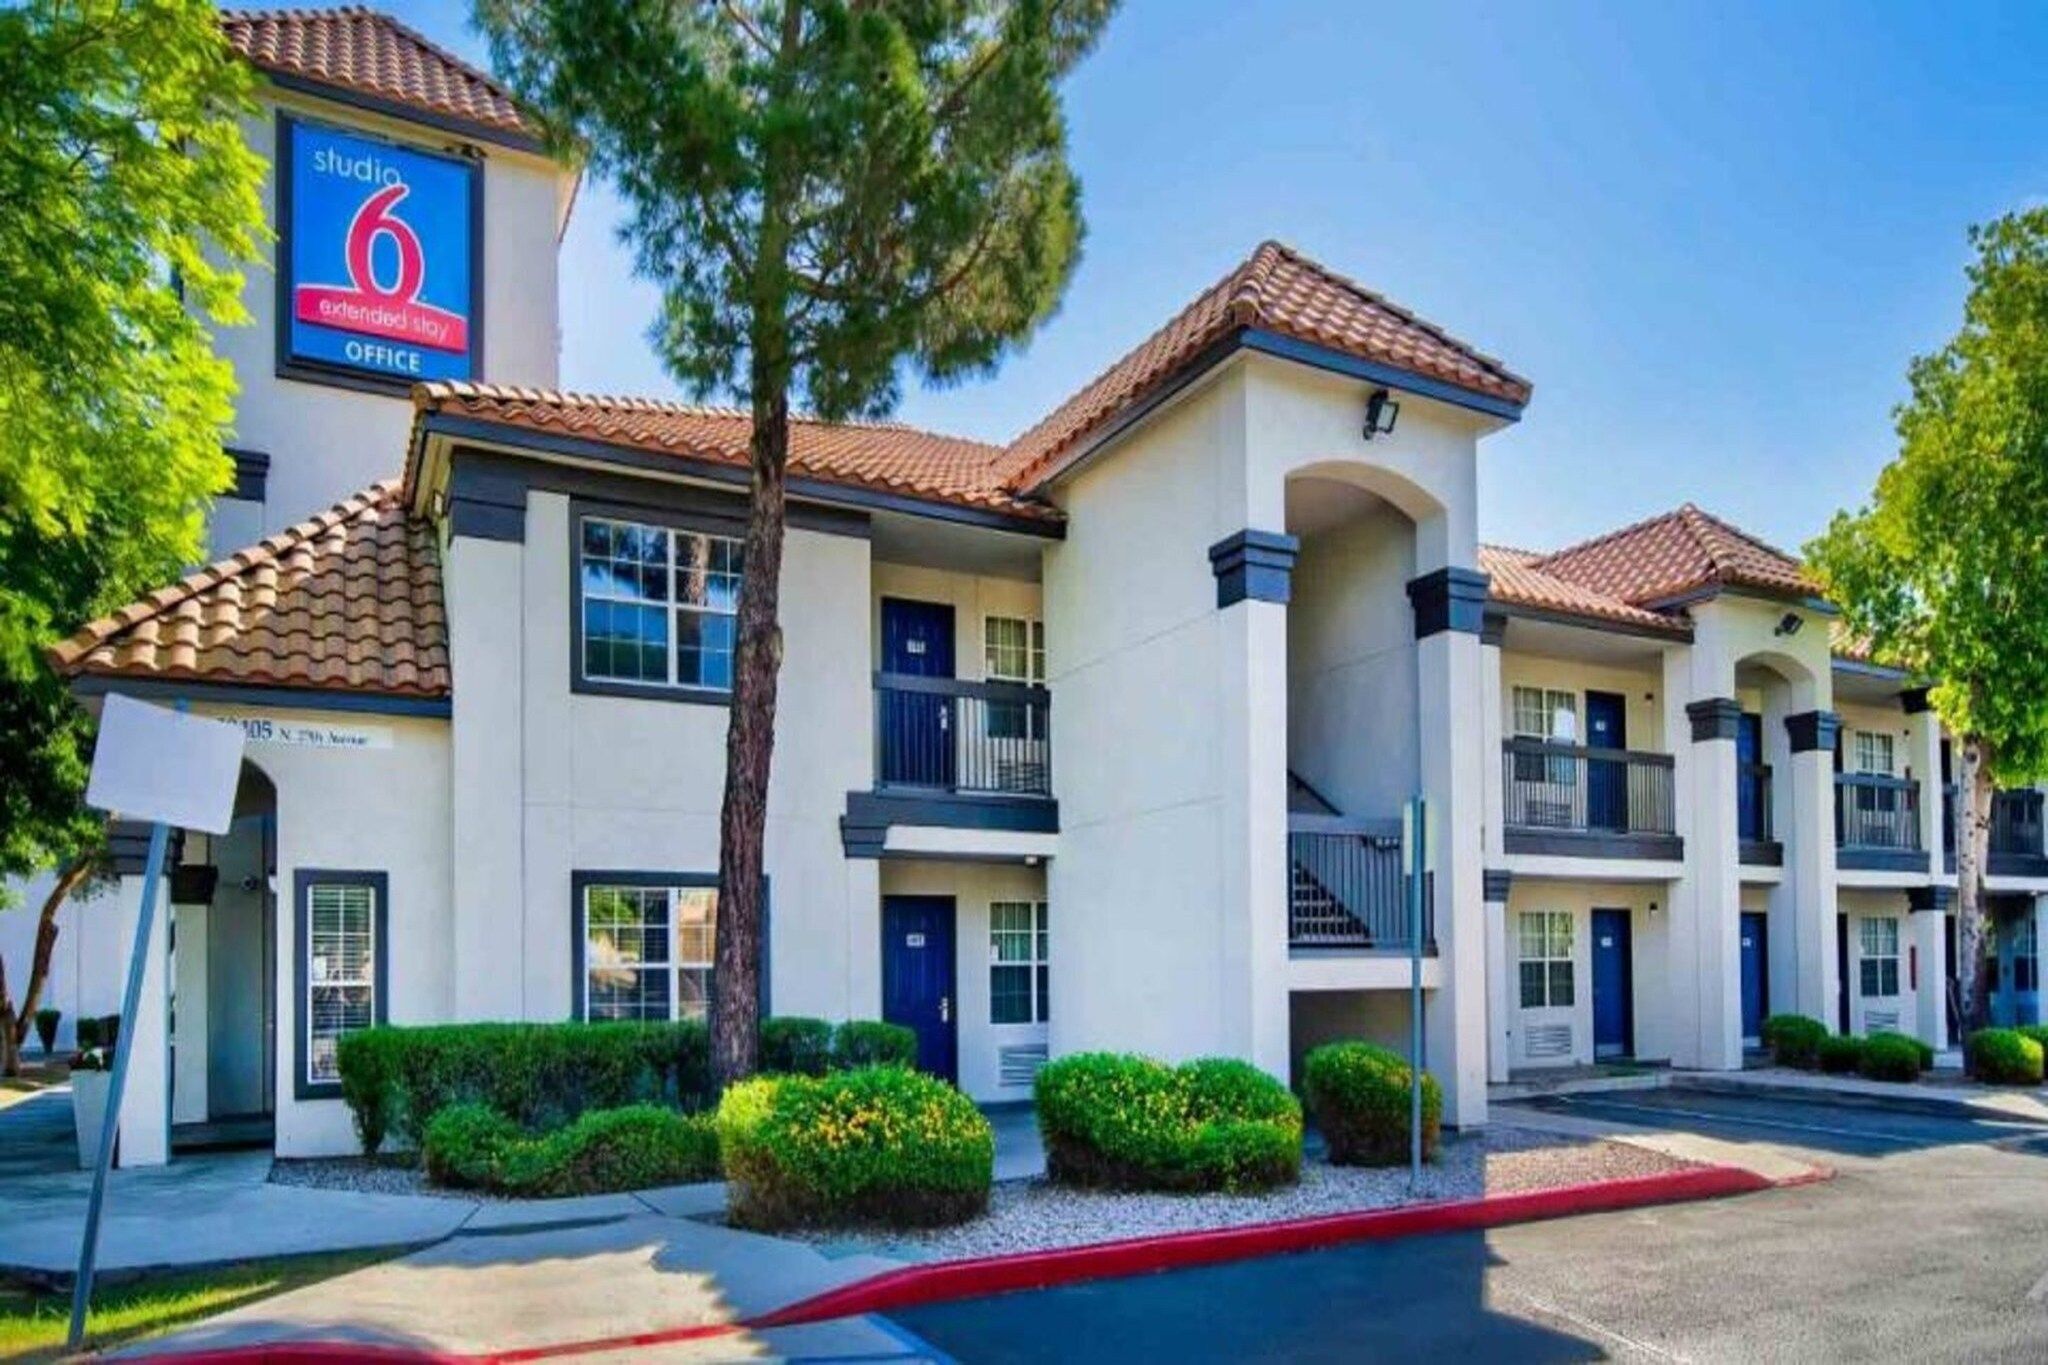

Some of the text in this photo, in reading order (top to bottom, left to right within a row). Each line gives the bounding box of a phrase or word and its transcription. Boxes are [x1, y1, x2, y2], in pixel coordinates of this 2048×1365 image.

[313, 146, 401, 186] studio
[345, 183, 425, 300] 6
[319, 298, 448, 343] extended stay
[344, 340, 421, 373] OFFICE
